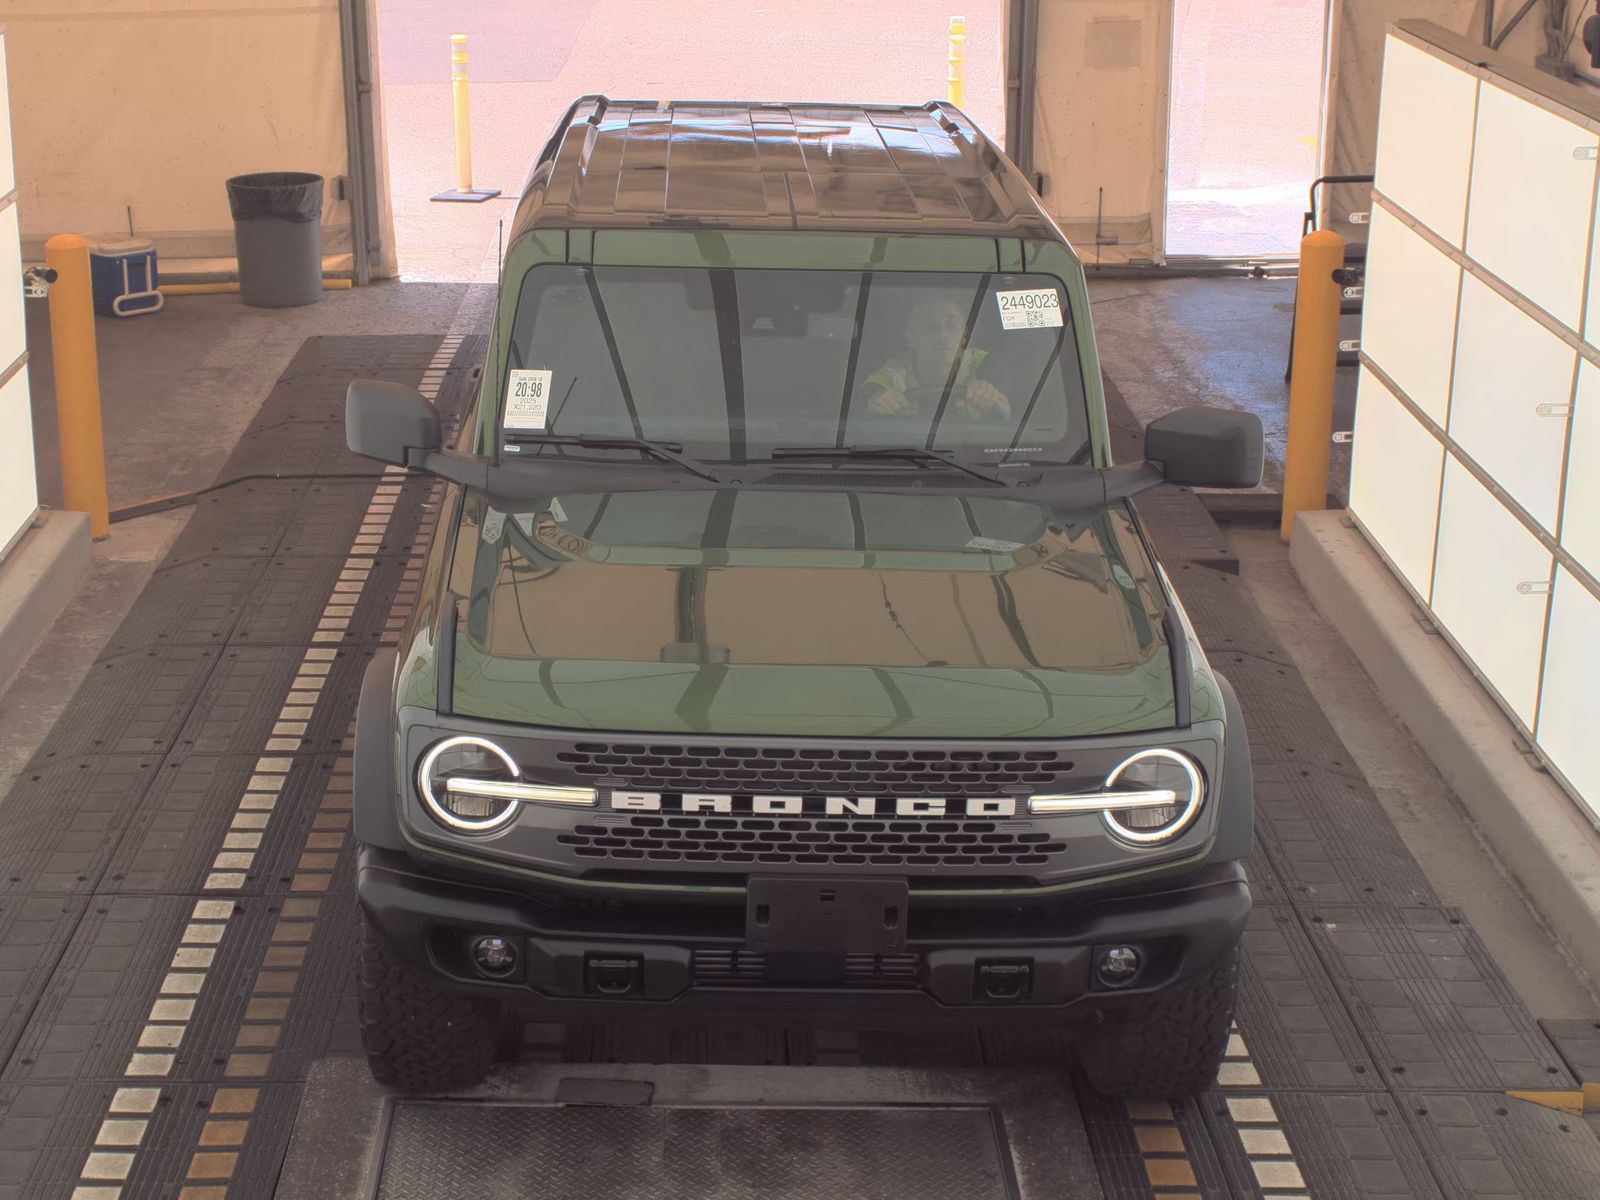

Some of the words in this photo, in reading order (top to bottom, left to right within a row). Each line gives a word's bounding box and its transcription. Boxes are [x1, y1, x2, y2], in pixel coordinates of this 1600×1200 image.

[1001, 294, 1059, 310] 2449023
[515, 382, 543, 398] 20:98
[611, 791, 1017, 817] BRONCO
